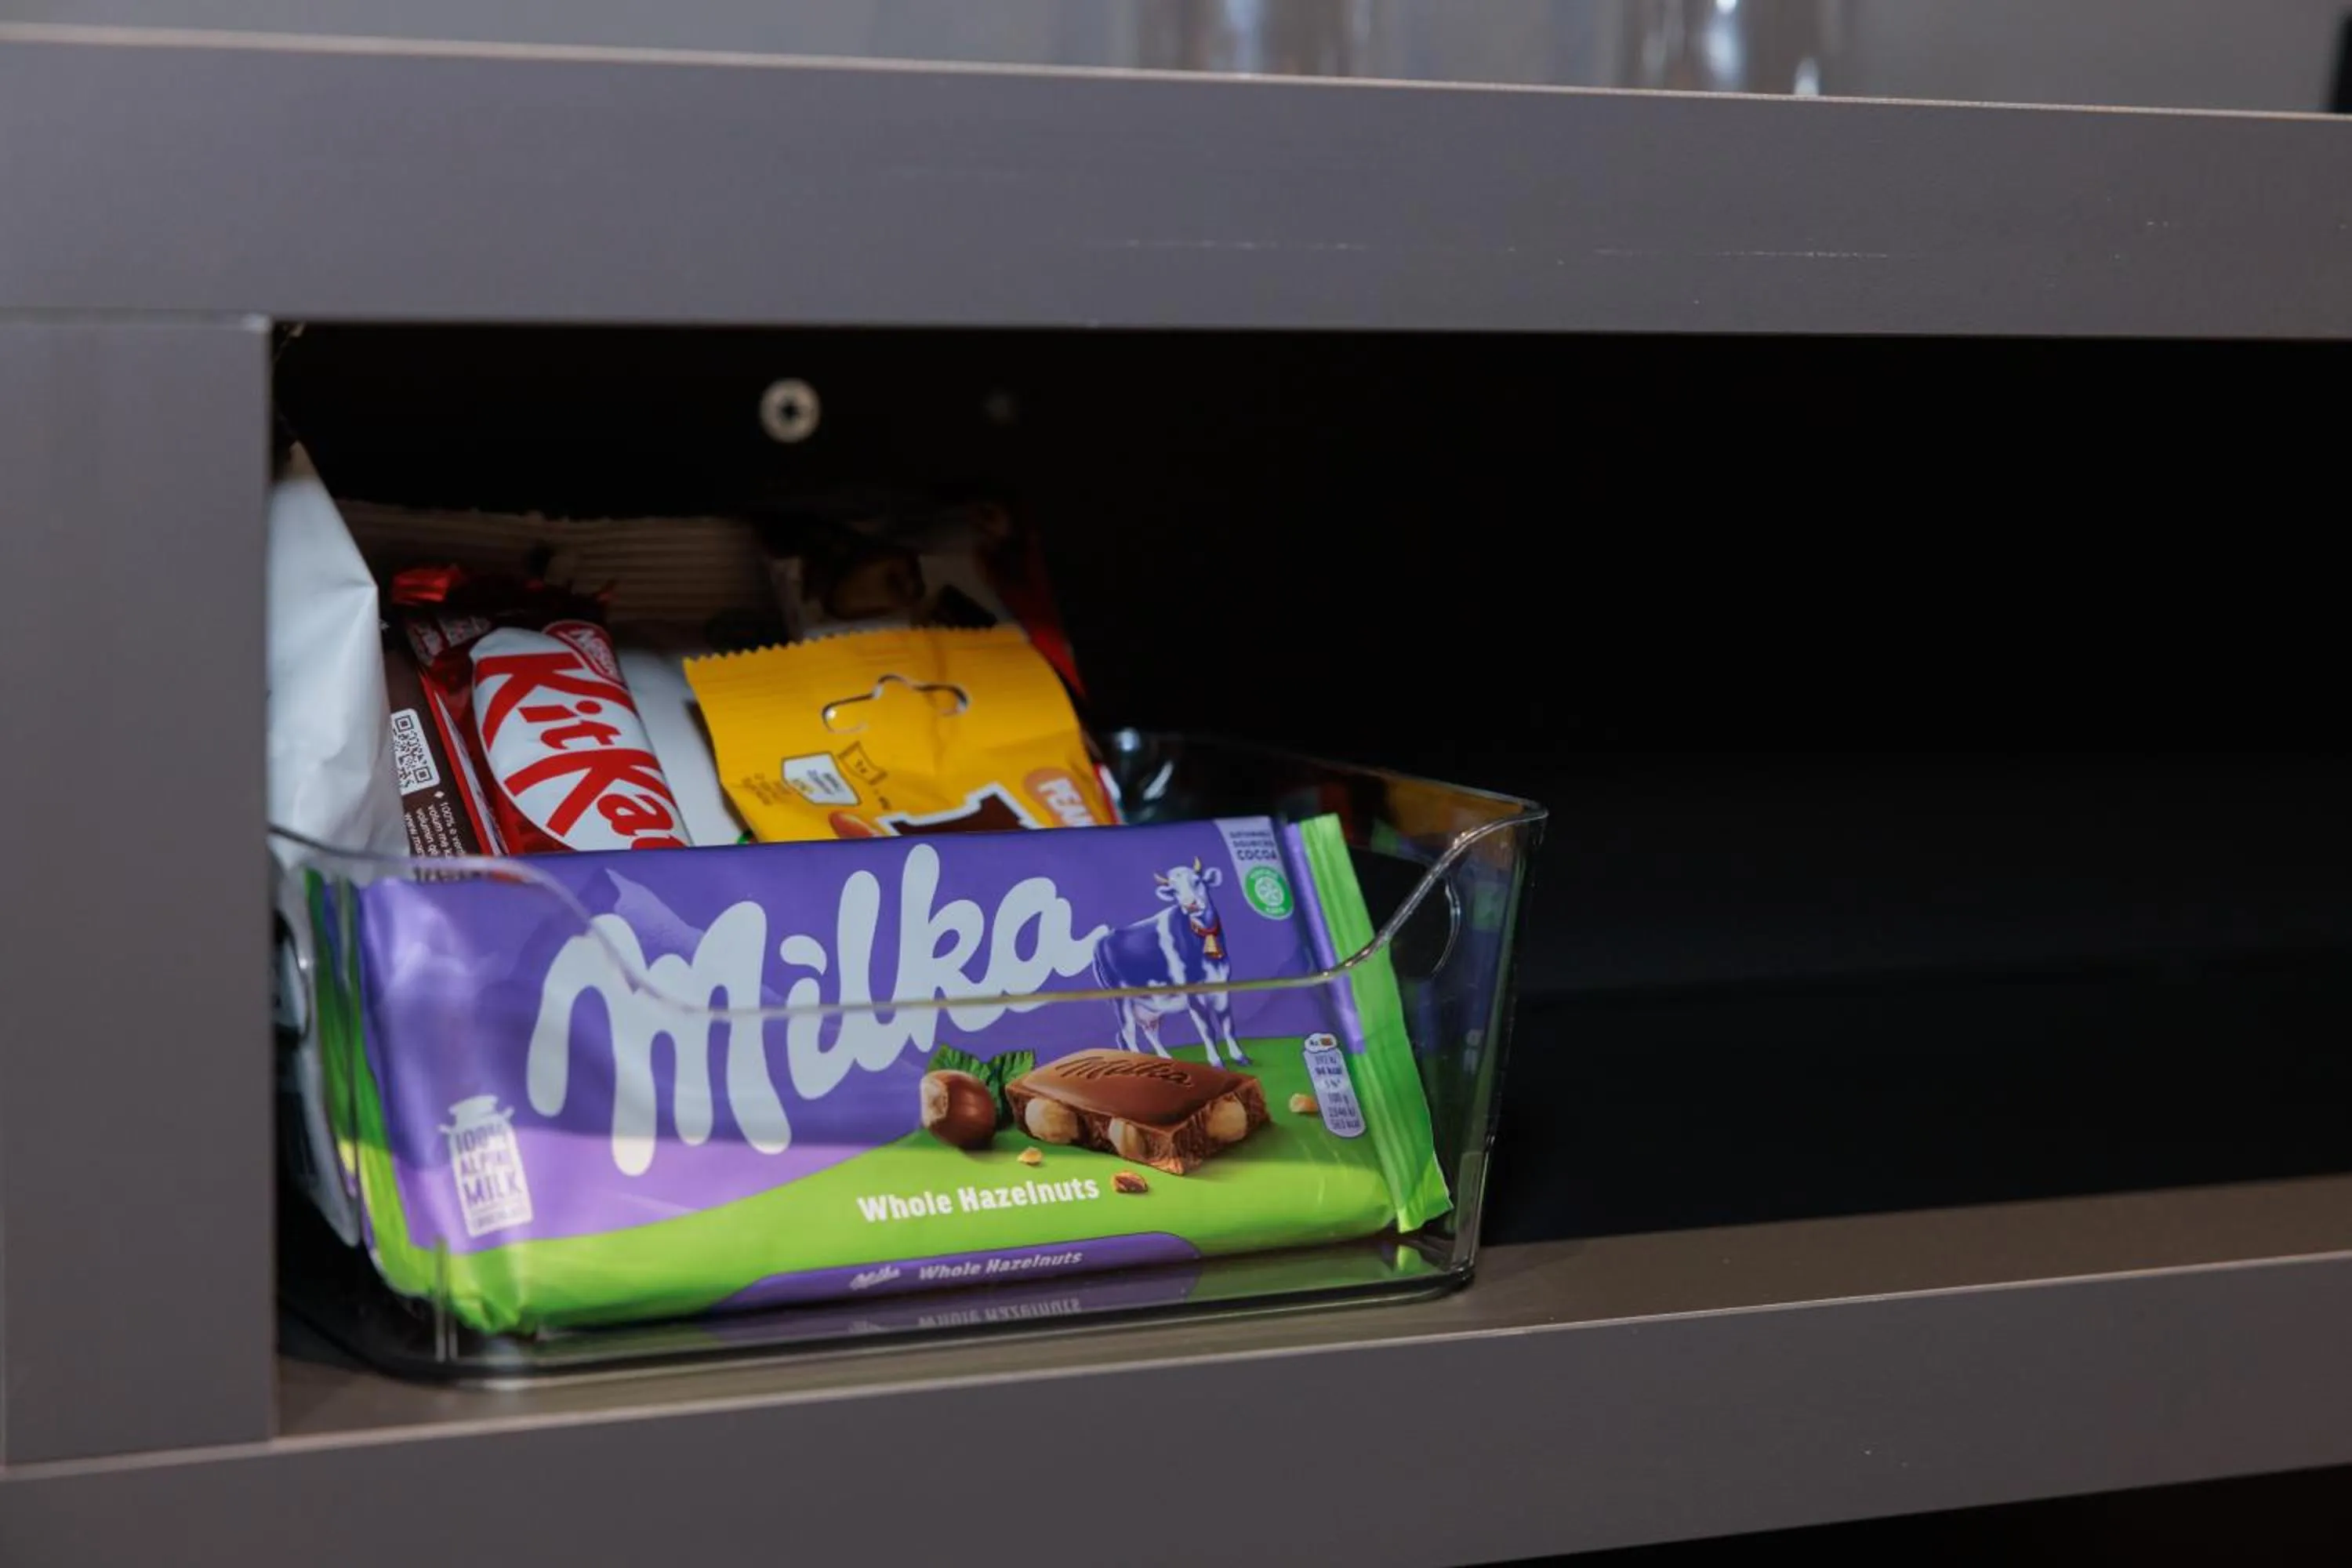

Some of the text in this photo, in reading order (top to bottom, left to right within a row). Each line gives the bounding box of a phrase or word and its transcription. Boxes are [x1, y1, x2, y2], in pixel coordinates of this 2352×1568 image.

[474, 652, 687, 849] KitKa
[1237, 849, 1278, 861] COCOA
[527, 844, 1109, 1175] Milka
[463, 1171, 524, 1205] MILK
[857, 1178, 1101, 1223] Whole Hazelnuts
[918, 1262, 982, 1281] Whole
[985, 1251, 1083, 1274] Hazelnuts
